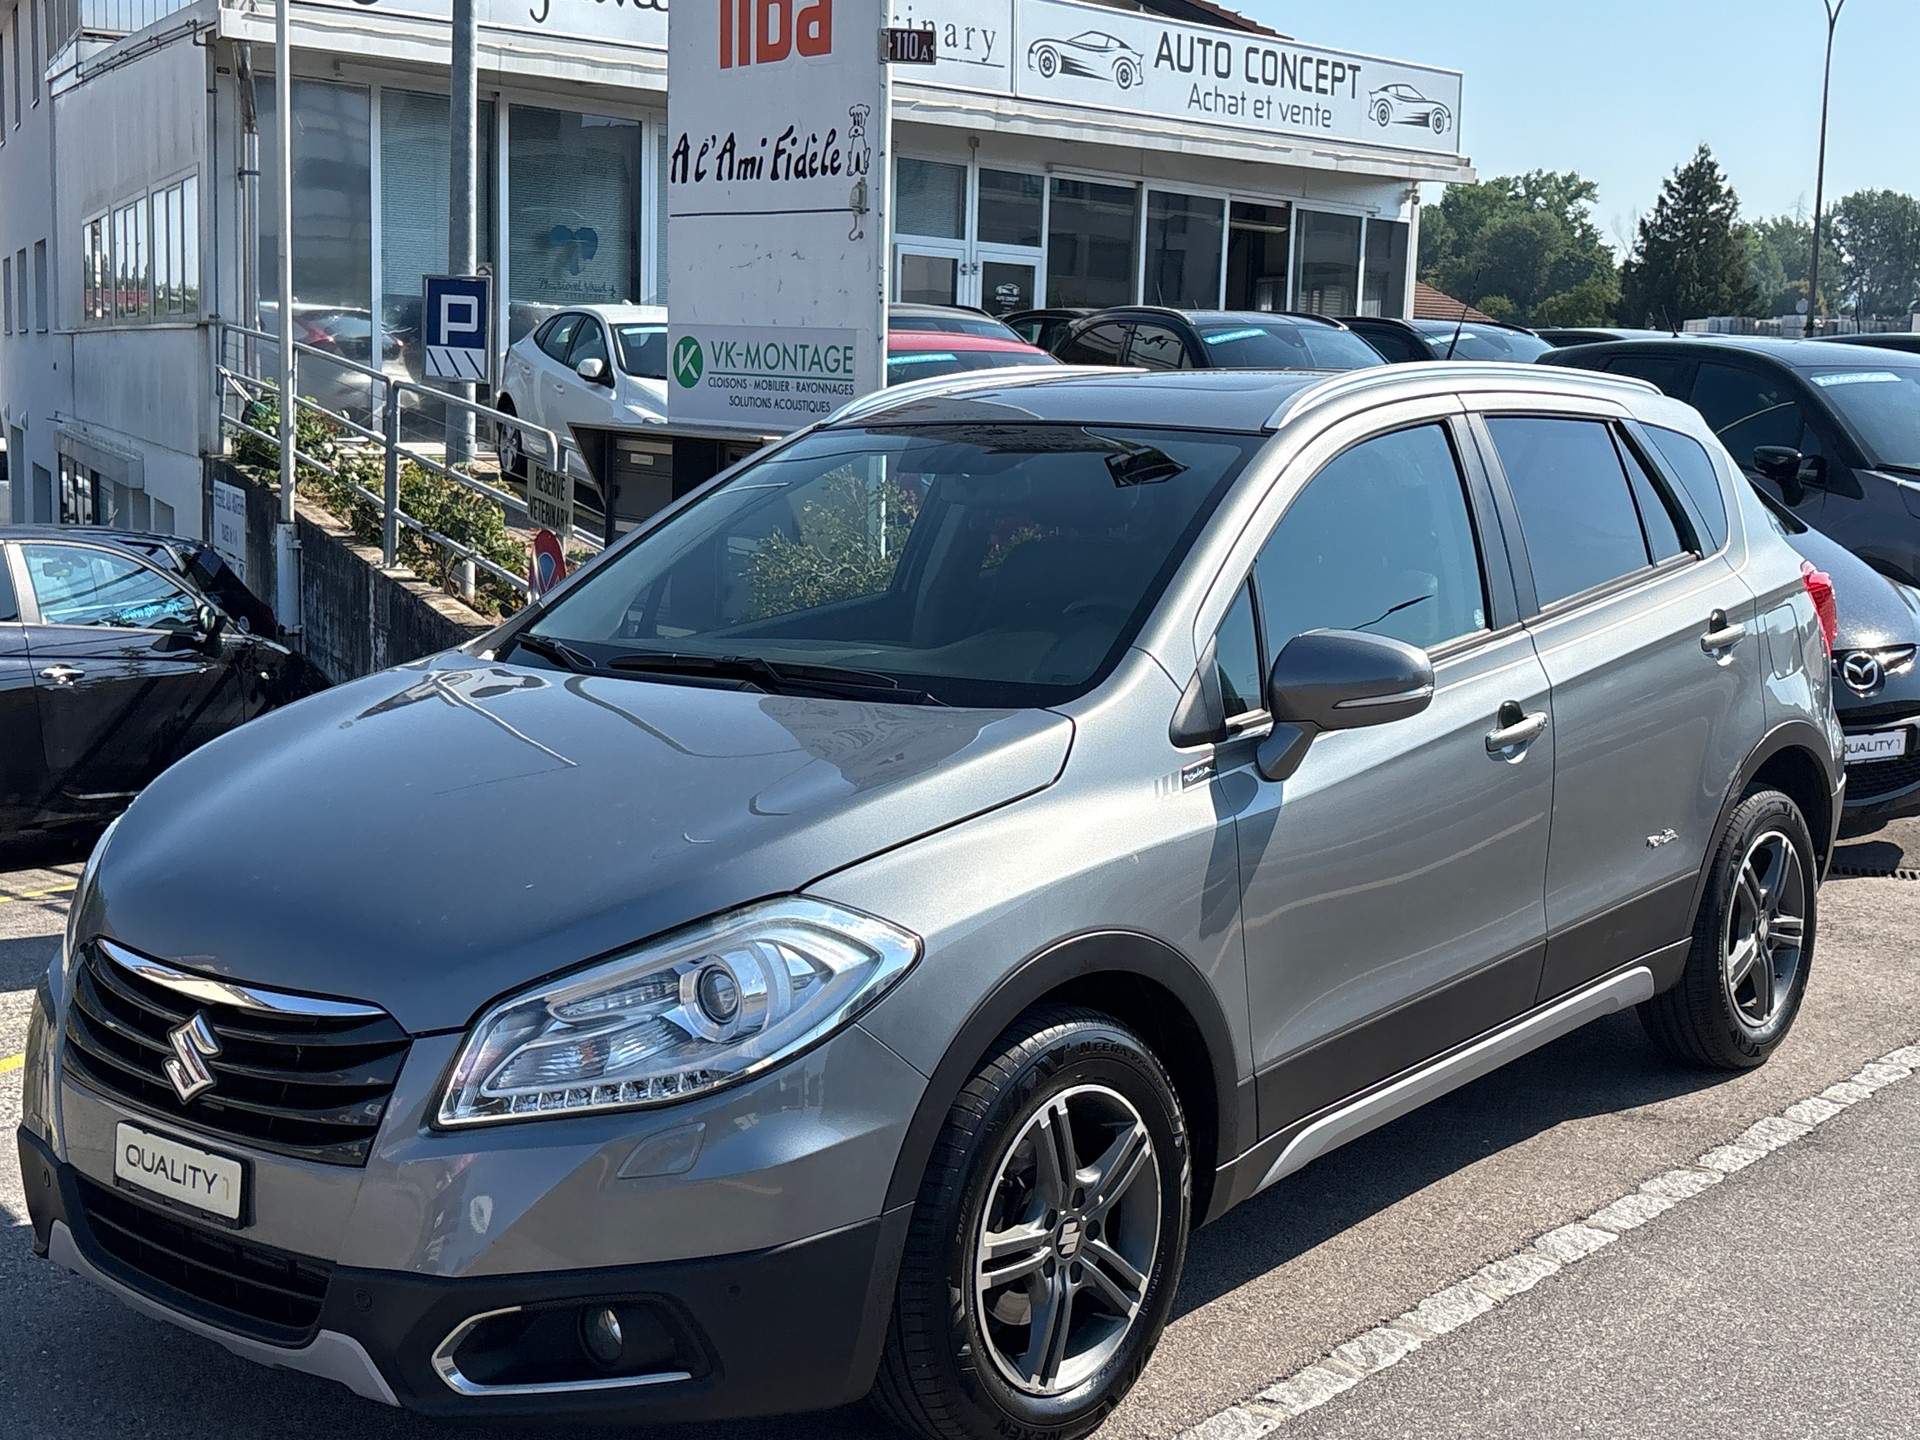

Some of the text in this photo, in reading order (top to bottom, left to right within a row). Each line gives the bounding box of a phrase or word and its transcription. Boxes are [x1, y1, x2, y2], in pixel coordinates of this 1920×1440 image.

[1154, 31, 1361, 99] AUTO CONCEPT
[1188, 83, 1332, 128] Achat et vente
[770, 124, 842, 181] Fidèle
[440, 294, 478, 344] P
[711, 340, 854, 374] VK-MONTAGE
[708, 377, 854, 396] CLOISONS MOBILIER RAYONNAGES
[729, 395, 830, 413] SOLUTIONS ACOUSTIQUES
[125, 1144, 218, 1195] QUALITY
